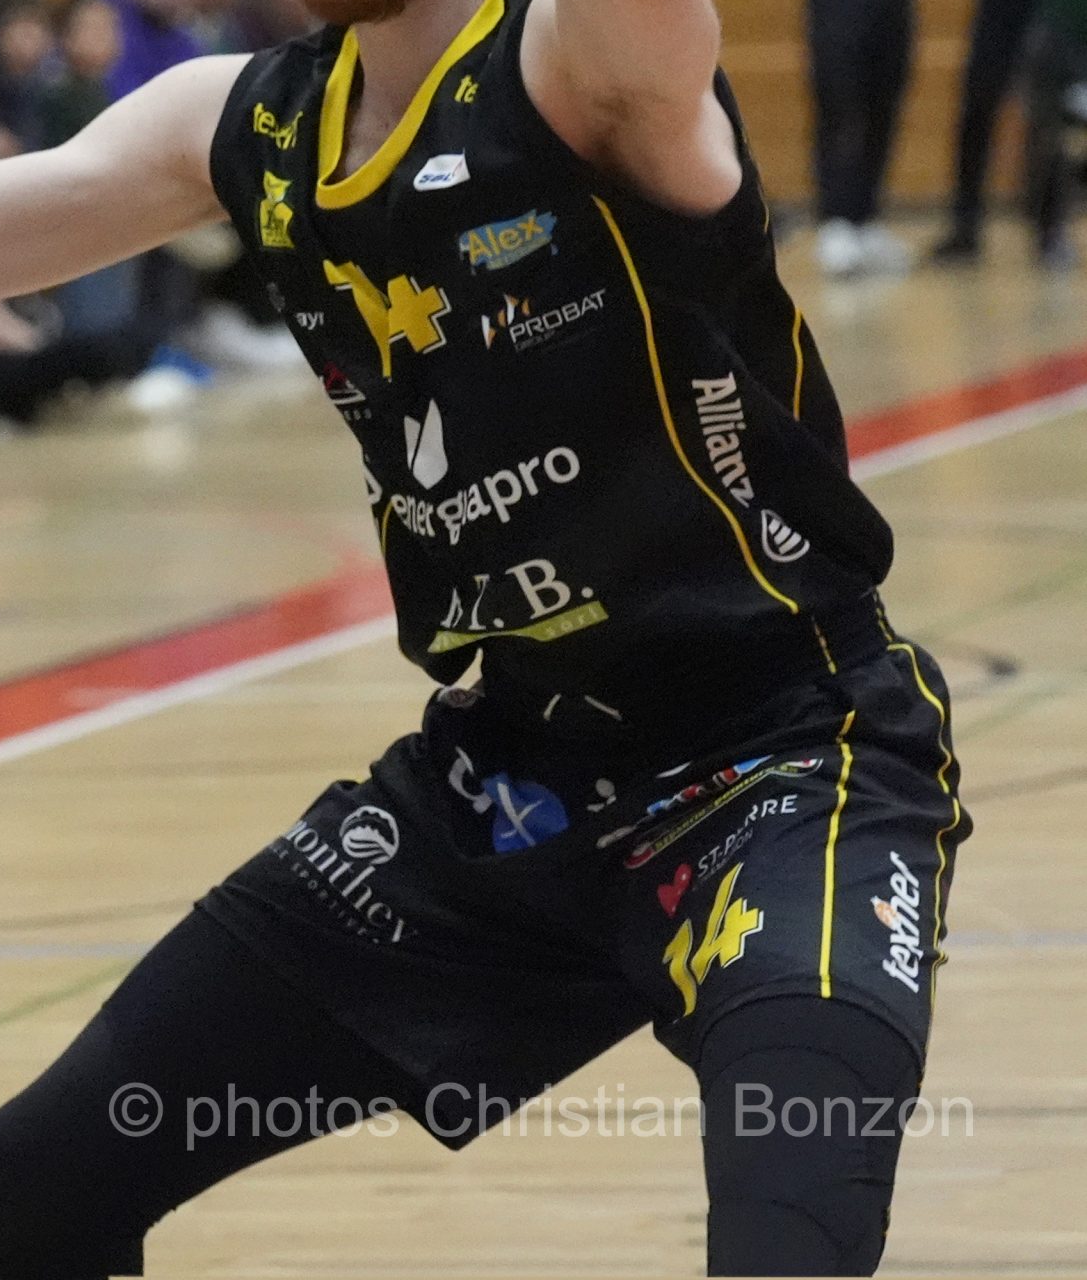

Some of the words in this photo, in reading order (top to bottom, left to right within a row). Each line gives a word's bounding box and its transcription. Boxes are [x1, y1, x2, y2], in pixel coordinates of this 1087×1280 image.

[466, 216, 546, 266] Alex
[509, 288, 608, 344] PROBAT
[691, 371, 755, 509] Allianz
[662, 862, 764, 1024] 14
